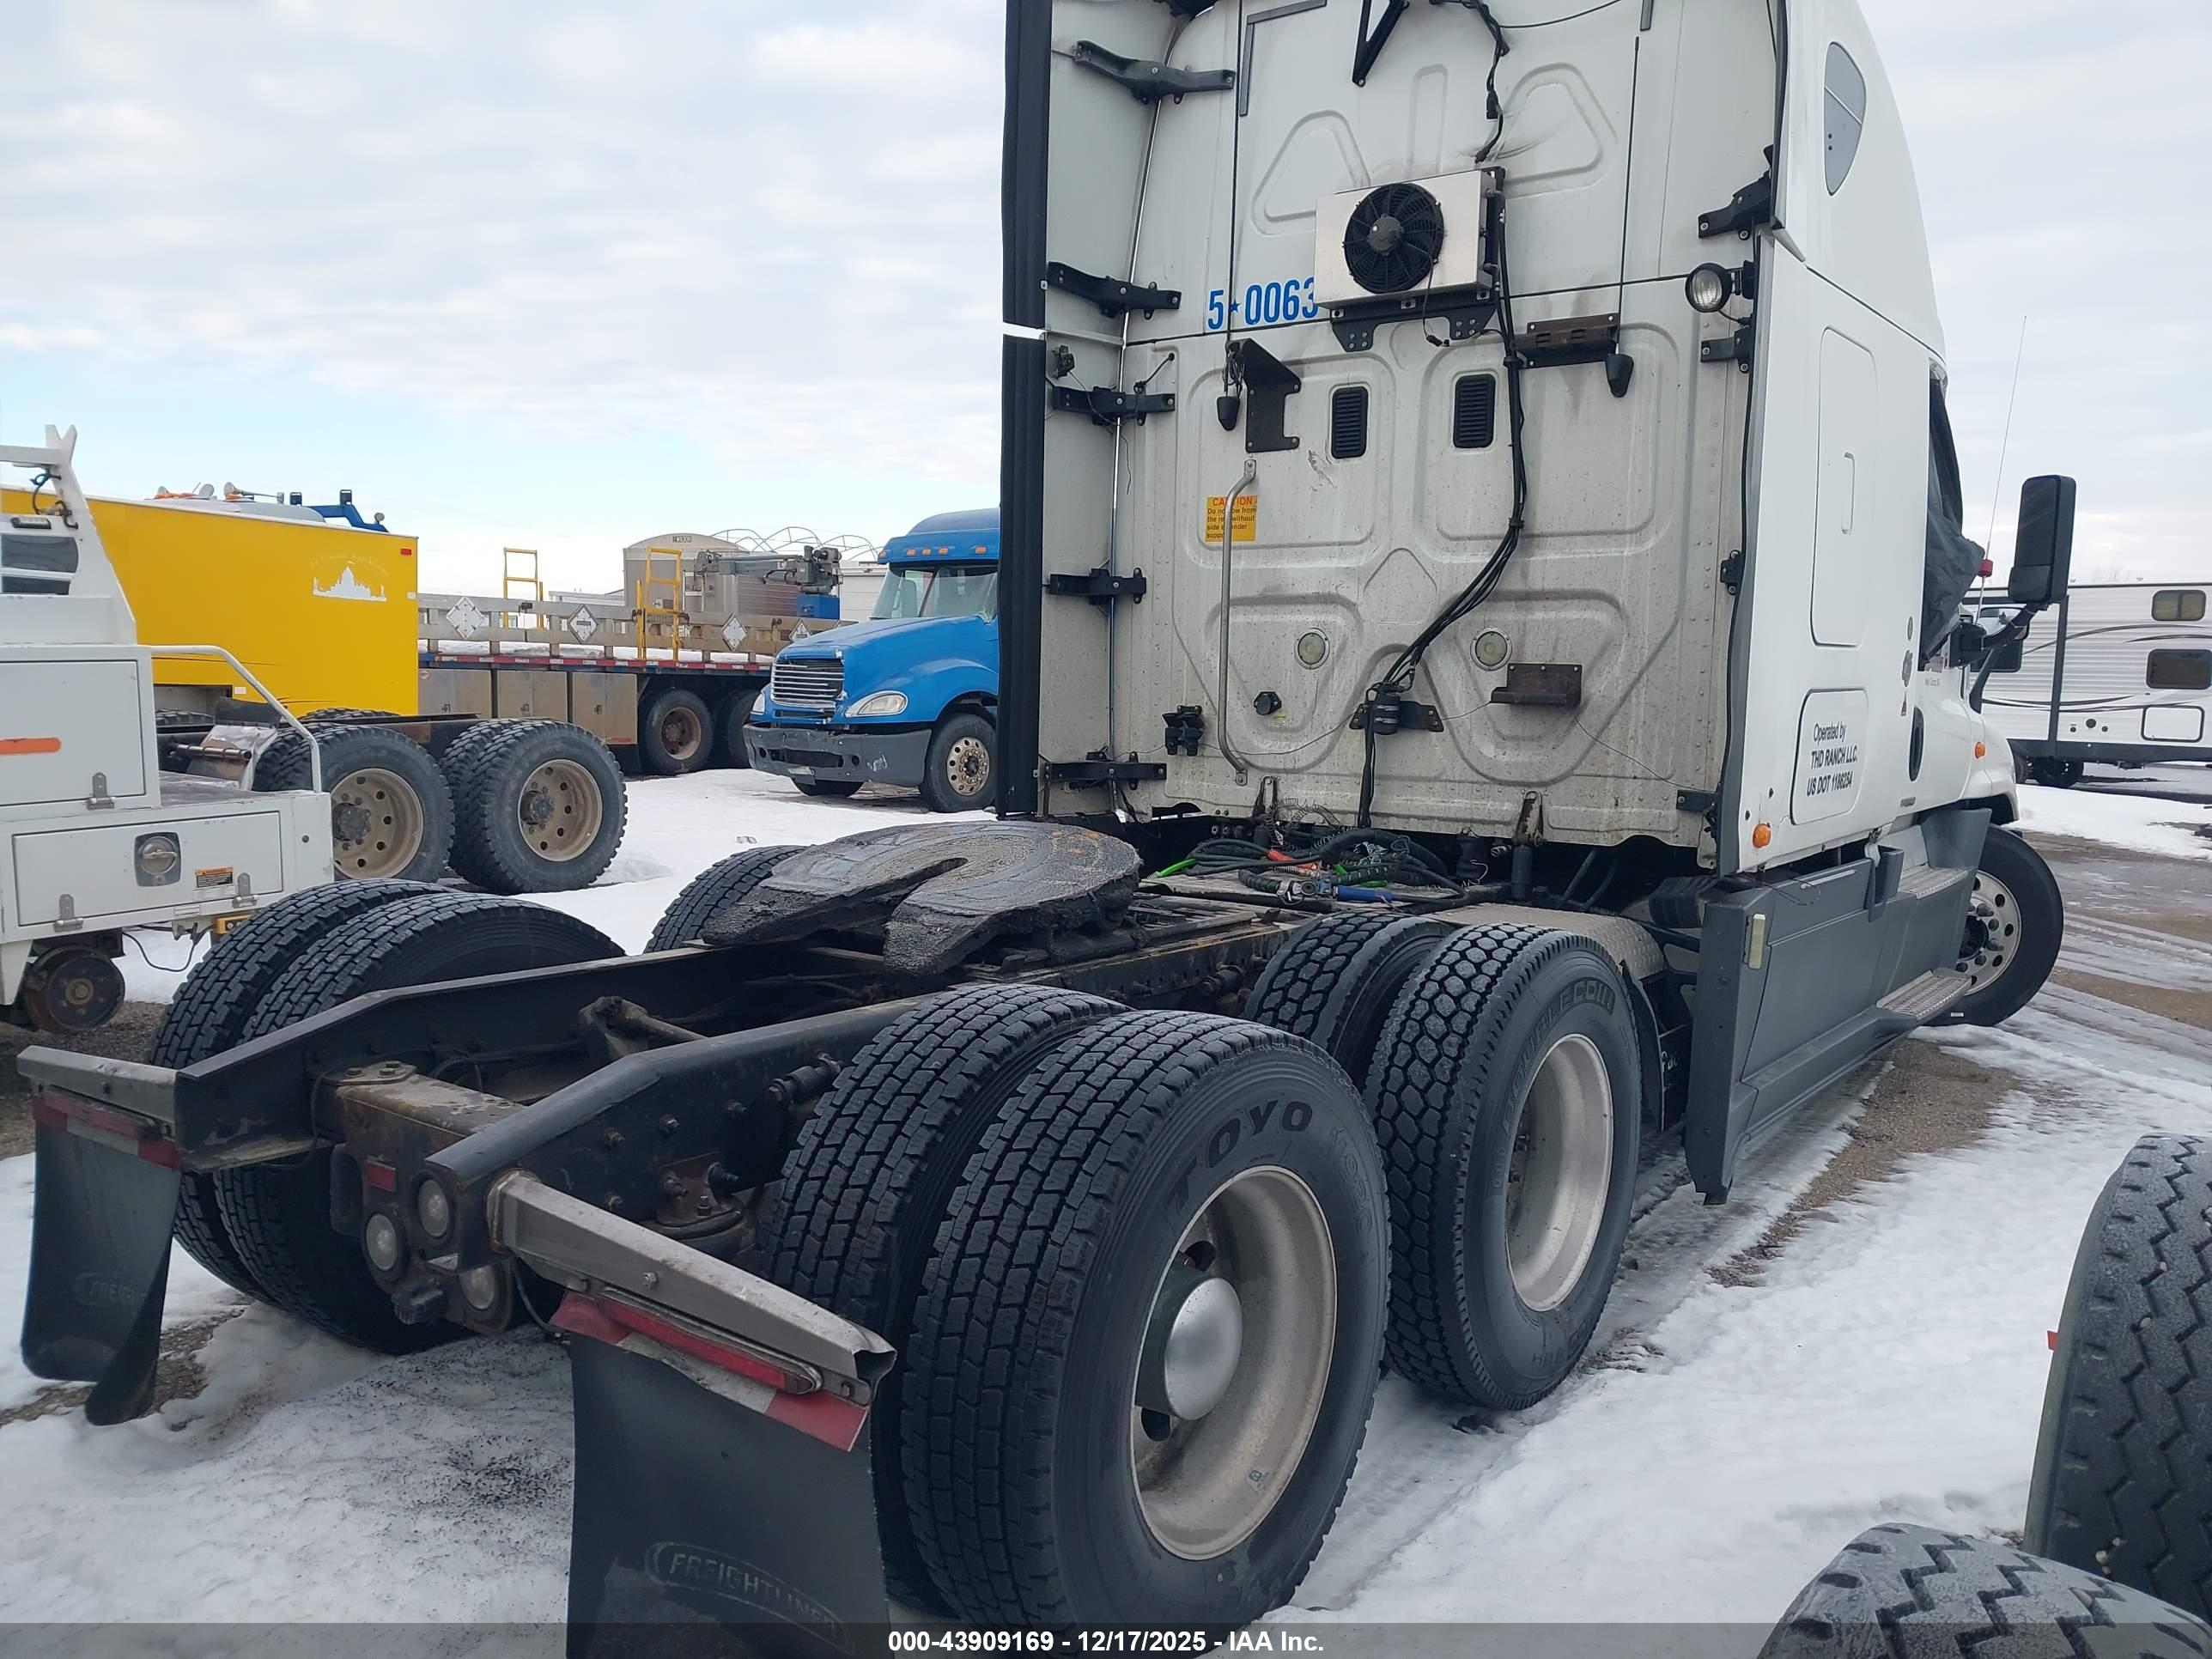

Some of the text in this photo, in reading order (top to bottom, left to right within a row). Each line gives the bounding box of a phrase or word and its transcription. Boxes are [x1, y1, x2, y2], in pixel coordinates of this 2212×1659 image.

[1212, 496, 1253, 507] CAION
[1814, 721, 1846, 745] Operated by
[1811, 750, 1825, 769] THD
[1825, 746, 1846, 767] RANCH
[1807, 777, 1817, 797] US
[1817, 775, 1832, 794] DOT
[1164, 1100, 1313, 1215] TOYO
